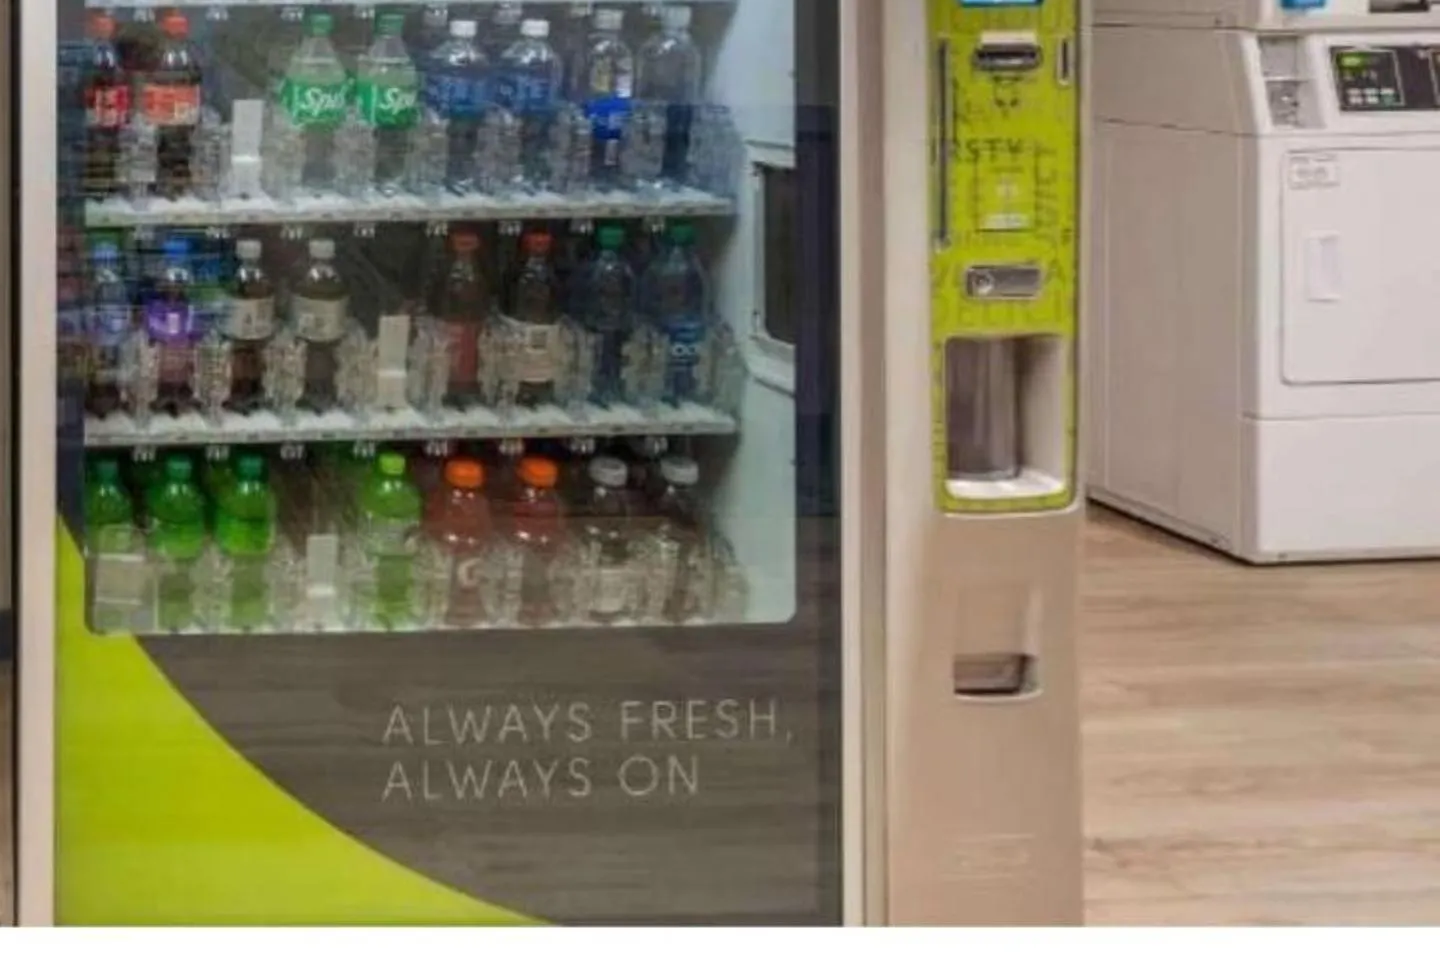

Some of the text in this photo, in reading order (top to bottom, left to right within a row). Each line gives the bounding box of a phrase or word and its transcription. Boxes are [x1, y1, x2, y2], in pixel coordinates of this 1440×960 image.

[382, 698, 792, 744] ALWAYS FRESH,
[382, 753, 700, 801] ALWAYS ON
